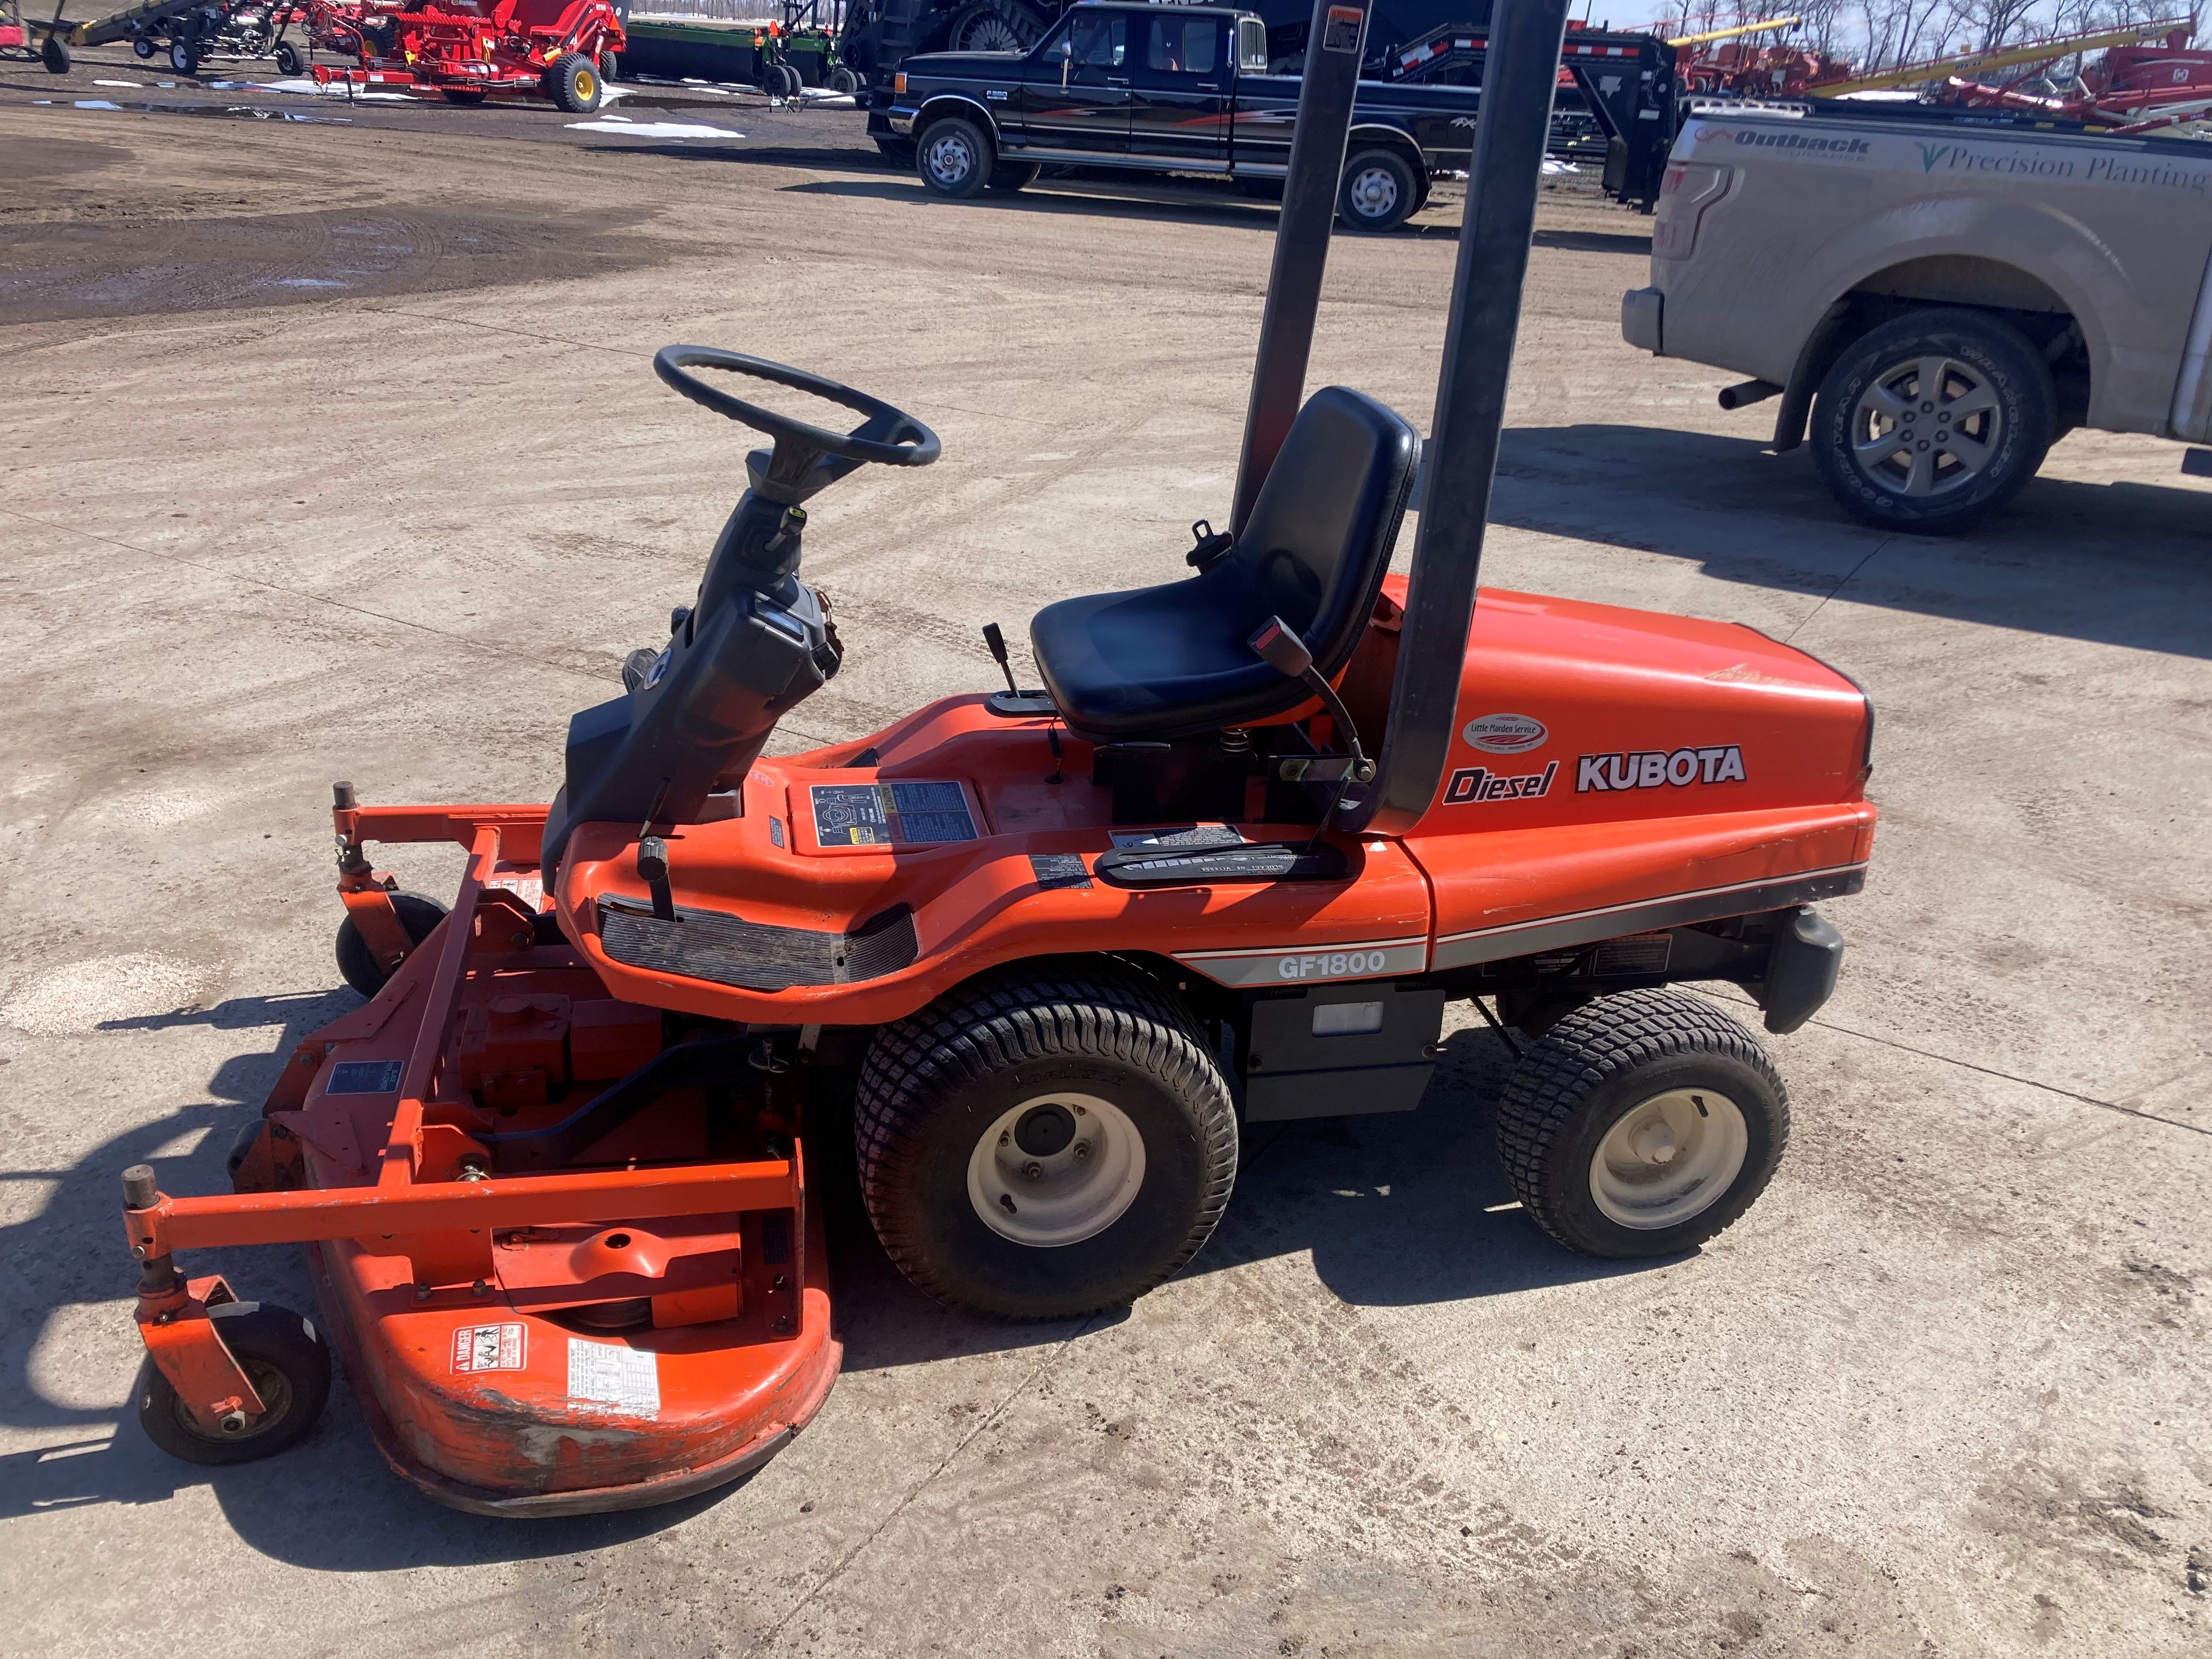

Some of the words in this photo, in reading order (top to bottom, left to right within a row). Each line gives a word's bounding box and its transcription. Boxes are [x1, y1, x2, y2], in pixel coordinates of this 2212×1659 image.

[1734, 130, 1872, 154] Outback
[1776, 149, 1867, 162] GUIDANCE
[1948, 146, 2074, 177] Precision
[2086, 156, 2212, 195] Planting
[1471, 723, 1488, 732] Little
[1489, 724, 1513, 733] Morden
[1514, 724, 1536, 734] Service
[1442, 760, 1559, 805] Diesel
[1576, 745, 1747, 793] KUBOTA
[882, 787, 894, 805] CAUTION
[1278, 950, 1386, 979] GF1800
[381, 1062, 393, 1092] REPLACEMENT
[456, 1329, 472, 1361] DANGER
